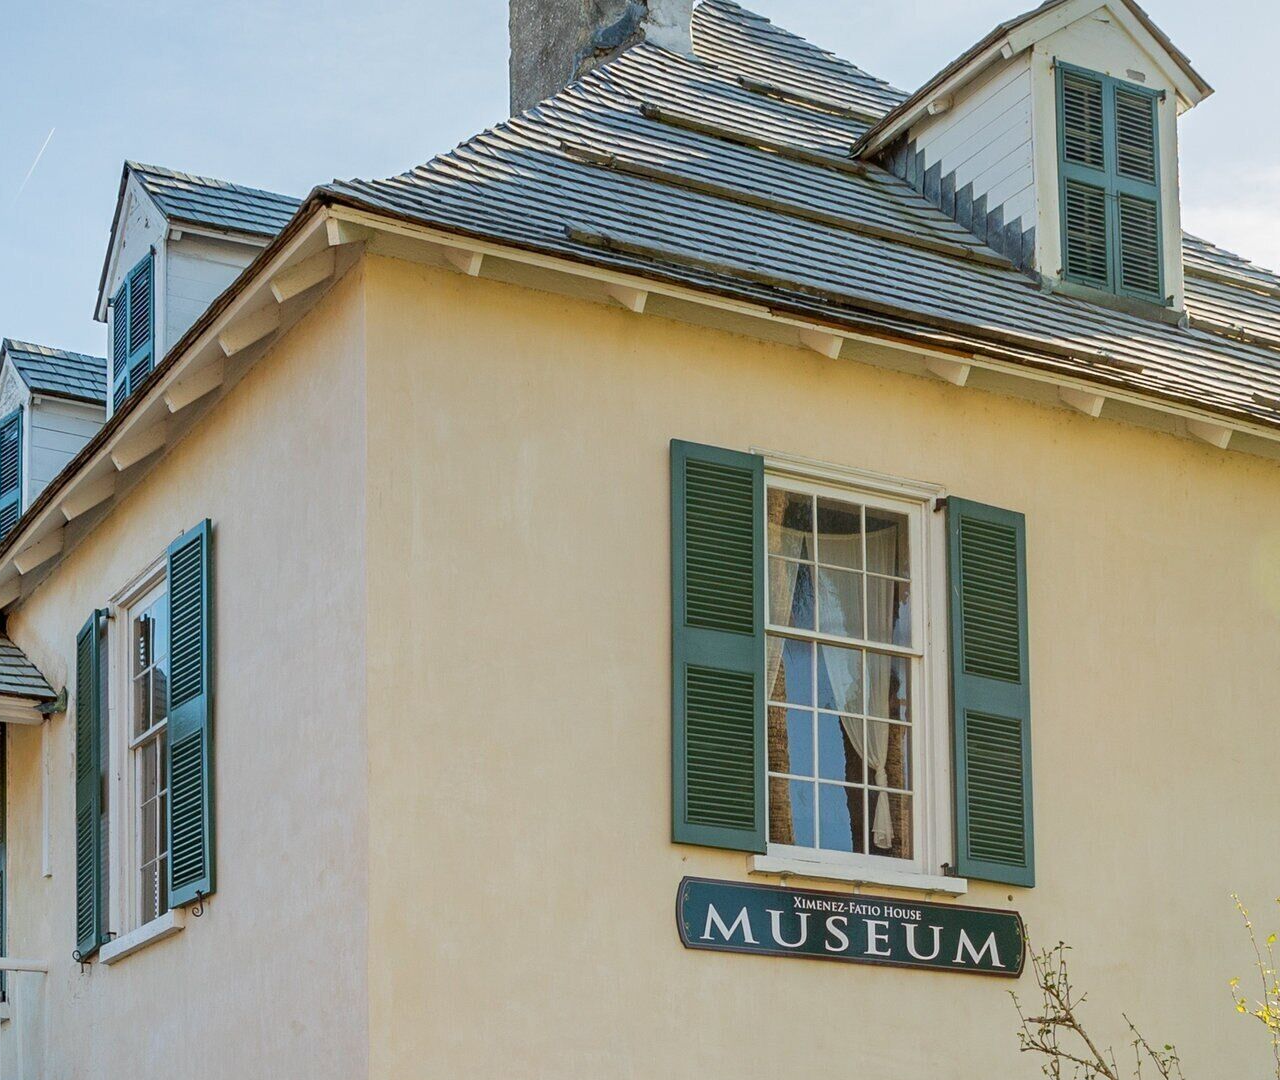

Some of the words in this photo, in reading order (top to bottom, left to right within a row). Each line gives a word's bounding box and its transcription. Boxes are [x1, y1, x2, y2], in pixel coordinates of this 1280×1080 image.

[793, 896, 881, 916] XIMENEZ-FATIO
[884, 906, 922, 921] HOUSE
[699, 903, 1006, 968] MUSEUM
